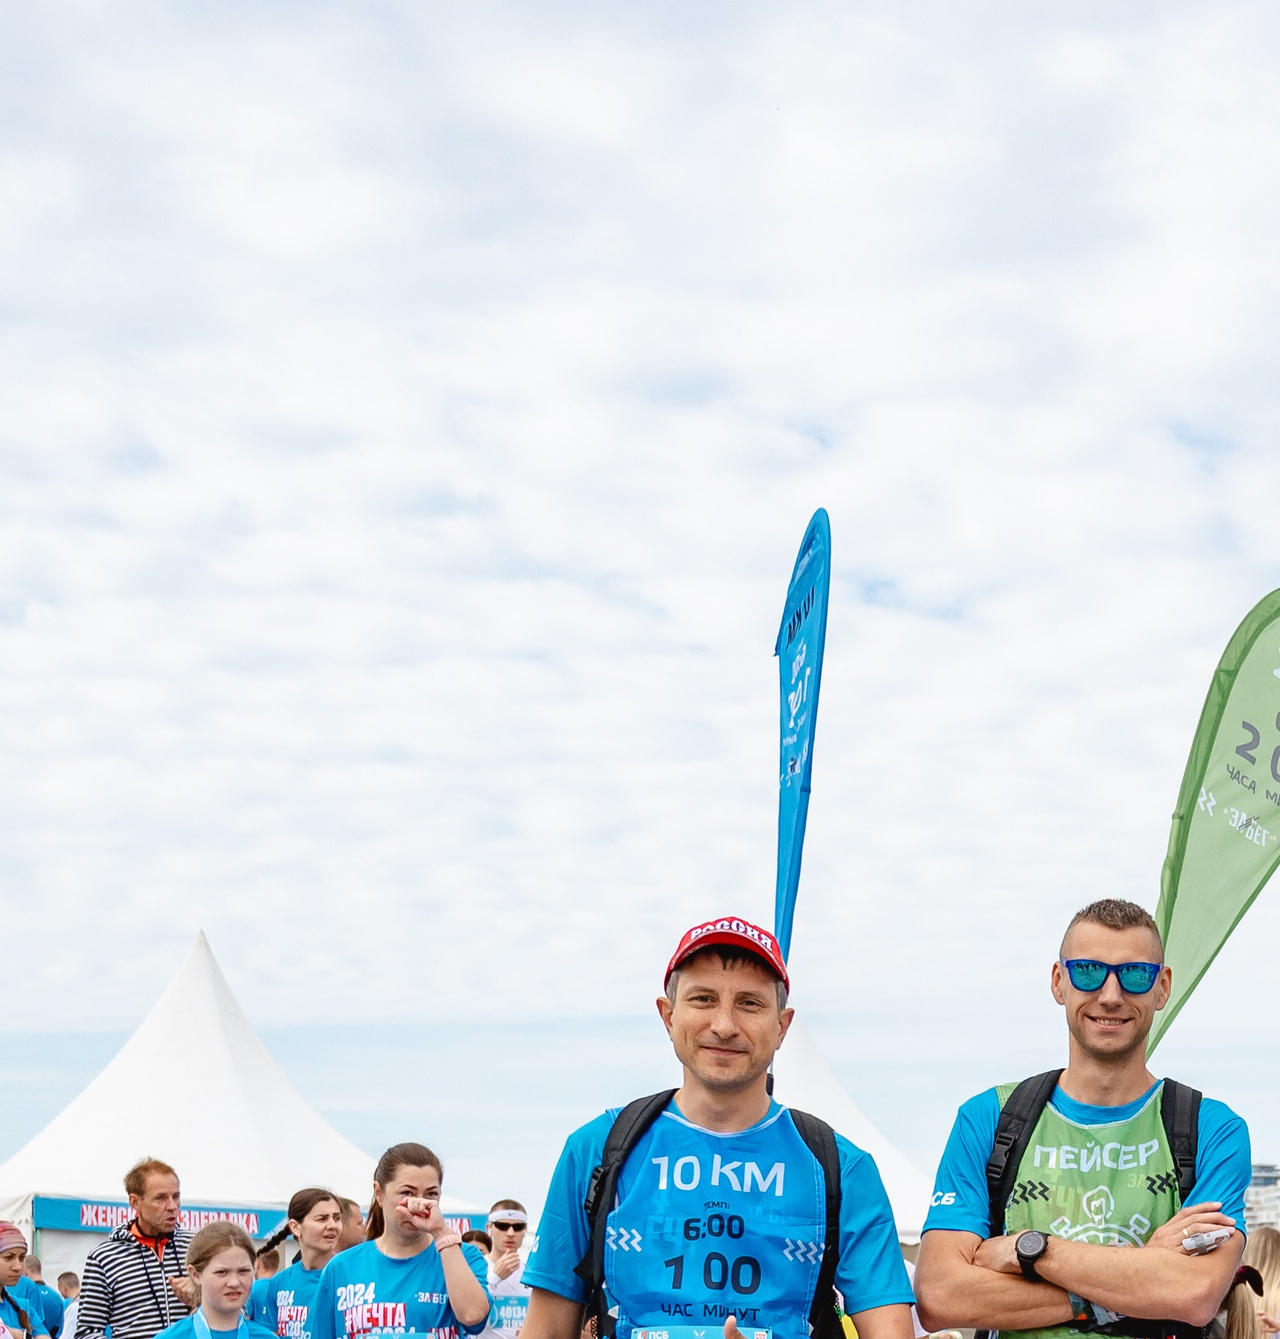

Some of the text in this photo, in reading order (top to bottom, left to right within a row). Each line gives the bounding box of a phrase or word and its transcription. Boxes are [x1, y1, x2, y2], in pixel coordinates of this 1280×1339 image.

[1235, 721, 1261, 766] 2
[1227, 763, 1256, 794] ЧАСА
[1033, 1138, 1160, 1173] ПЕЙСЕР
[652, 1154, 786, 1197] 10 KM
[704, 1201, 731, 1210] ТЕМП:
[930, 1191, 956, 1207] СБ
[80, 1204, 137, 1228] ЖЕНСК
[683, 1213, 744, 1241] 6:00
[664, 1252, 761, 1295] 1 00
[336, 1282, 376, 1311] 2024
[344, 1302, 407, 1334] #МЕЧТА
[661, 1303, 760, 1321] ЧАС МИНУТ
[649, 1331, 669, 1339] ПСБ
